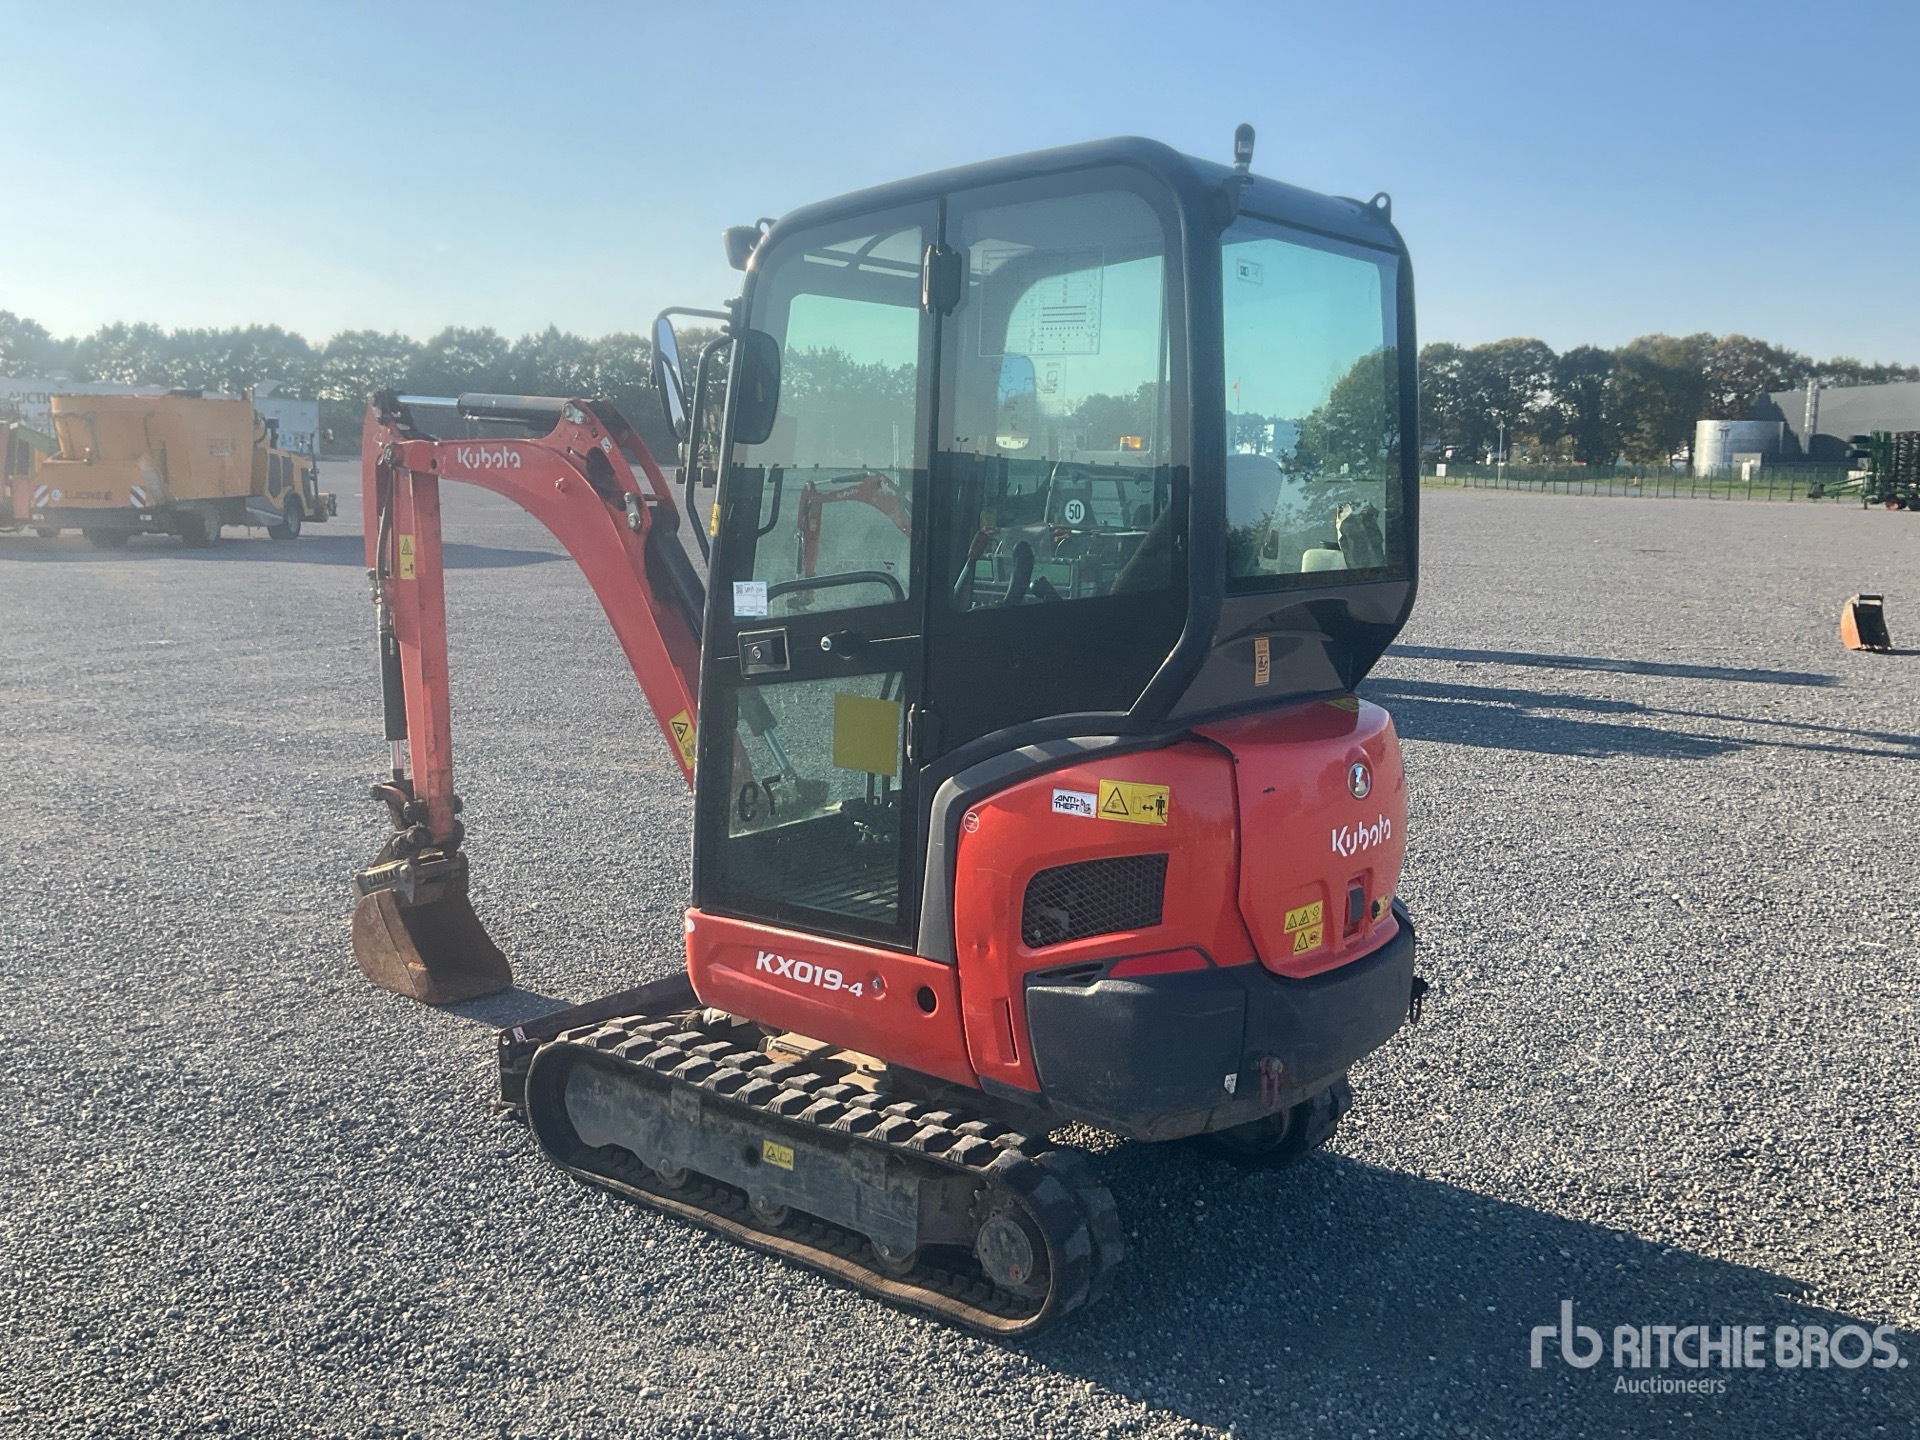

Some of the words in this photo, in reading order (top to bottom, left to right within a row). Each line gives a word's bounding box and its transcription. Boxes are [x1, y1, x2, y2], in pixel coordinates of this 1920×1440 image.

[457, 446, 521, 469] Kubota
[1068, 503, 1081, 520] 50
[1054, 801, 1080, 812] THEFT
[1331, 813, 1391, 857] Kubota
[756, 950, 863, 997] KX019-4
